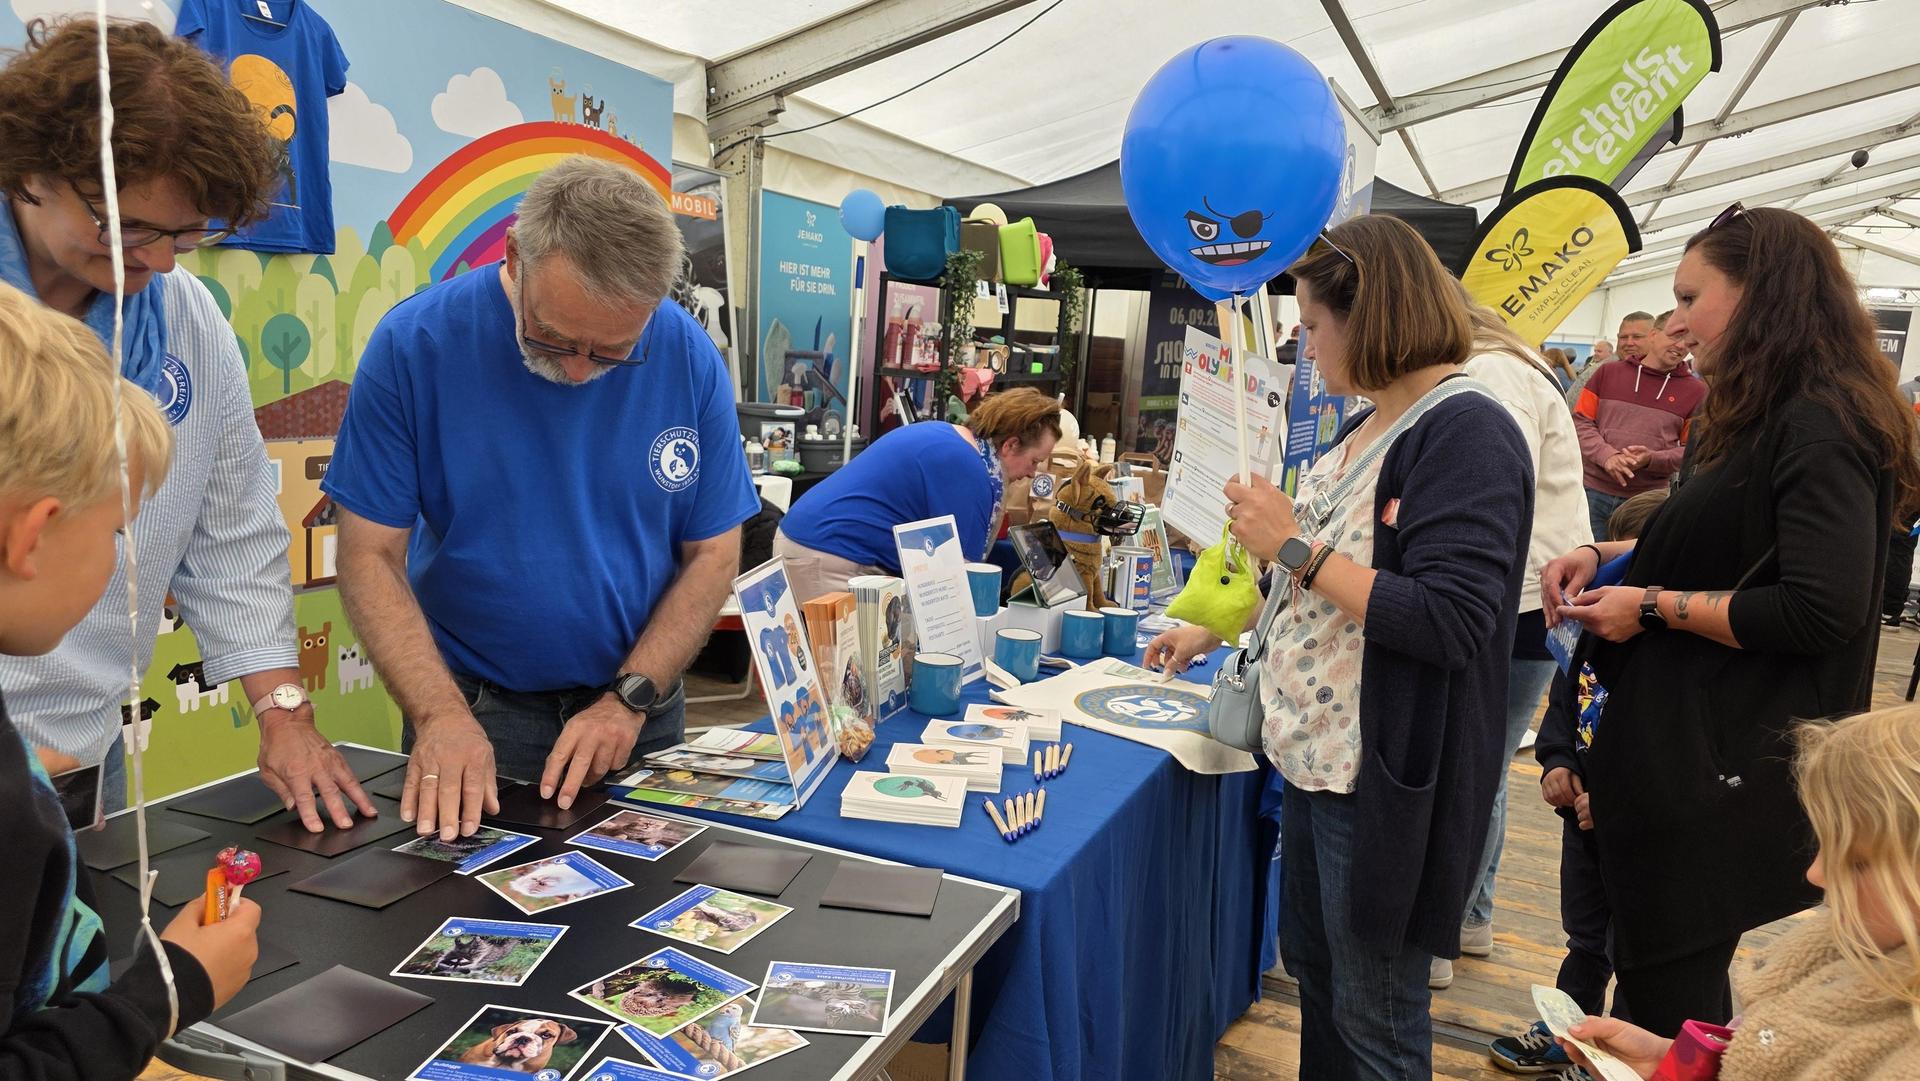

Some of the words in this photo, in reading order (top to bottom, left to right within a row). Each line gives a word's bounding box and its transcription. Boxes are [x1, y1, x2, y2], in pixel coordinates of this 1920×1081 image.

[1596, 44, 1693, 165] event
[672, 195, 715, 216] MOBIL
[797, 230, 824, 243] JEMAKO
[779, 261, 798, 273] HIER
[799, 266, 810, 276] IST
[810, 267, 831, 279] MEHR
[1497, 226, 1594, 322] EMAKO
[790, 277, 806, 291] FÜR
[807, 282, 817, 293] SIE
[818, 283, 836, 296] DRIN.
[1529, 287, 1560, 321] SIMPLY
[1560, 258, 1594, 288] CLEAN.
[432, 1061, 462, 1070] Bulldogge
